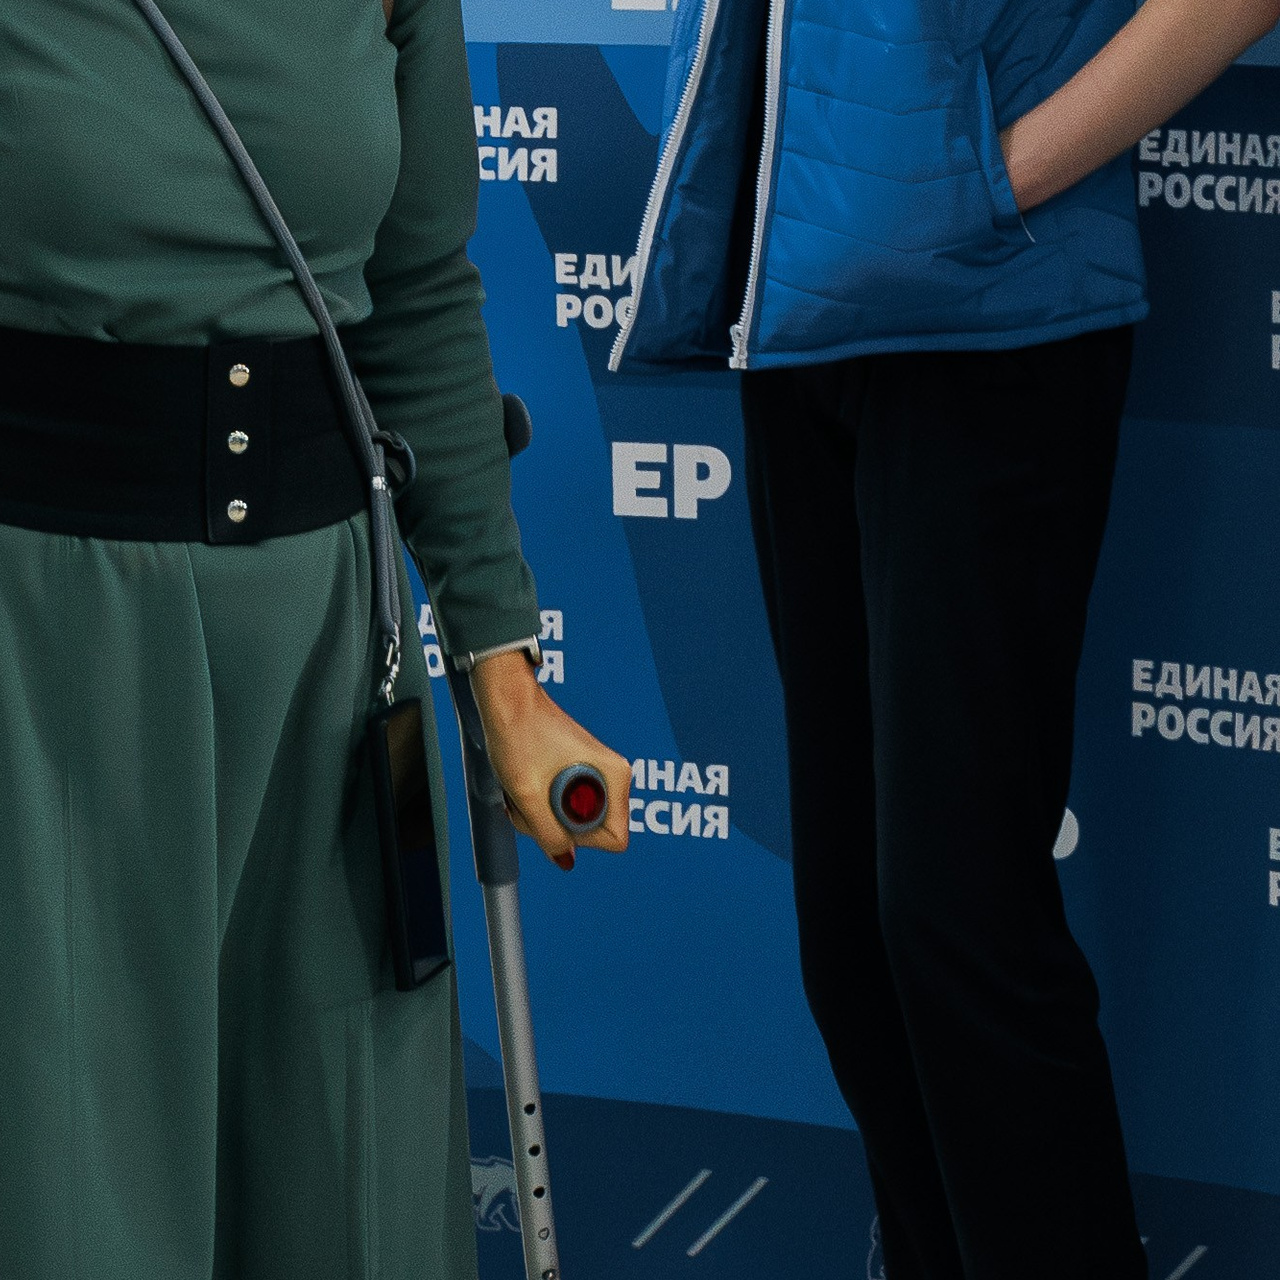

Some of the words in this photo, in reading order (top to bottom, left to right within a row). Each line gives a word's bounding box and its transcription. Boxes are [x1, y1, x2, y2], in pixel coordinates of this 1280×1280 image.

[473, 105, 558, 139] НАЯ
[478, 146, 558, 183] СИЯ
[611, 441, 732, 519] ЕР
[631, 758, 729, 796] ИНАЯ
[629, 797, 729, 840] ССИЯ
